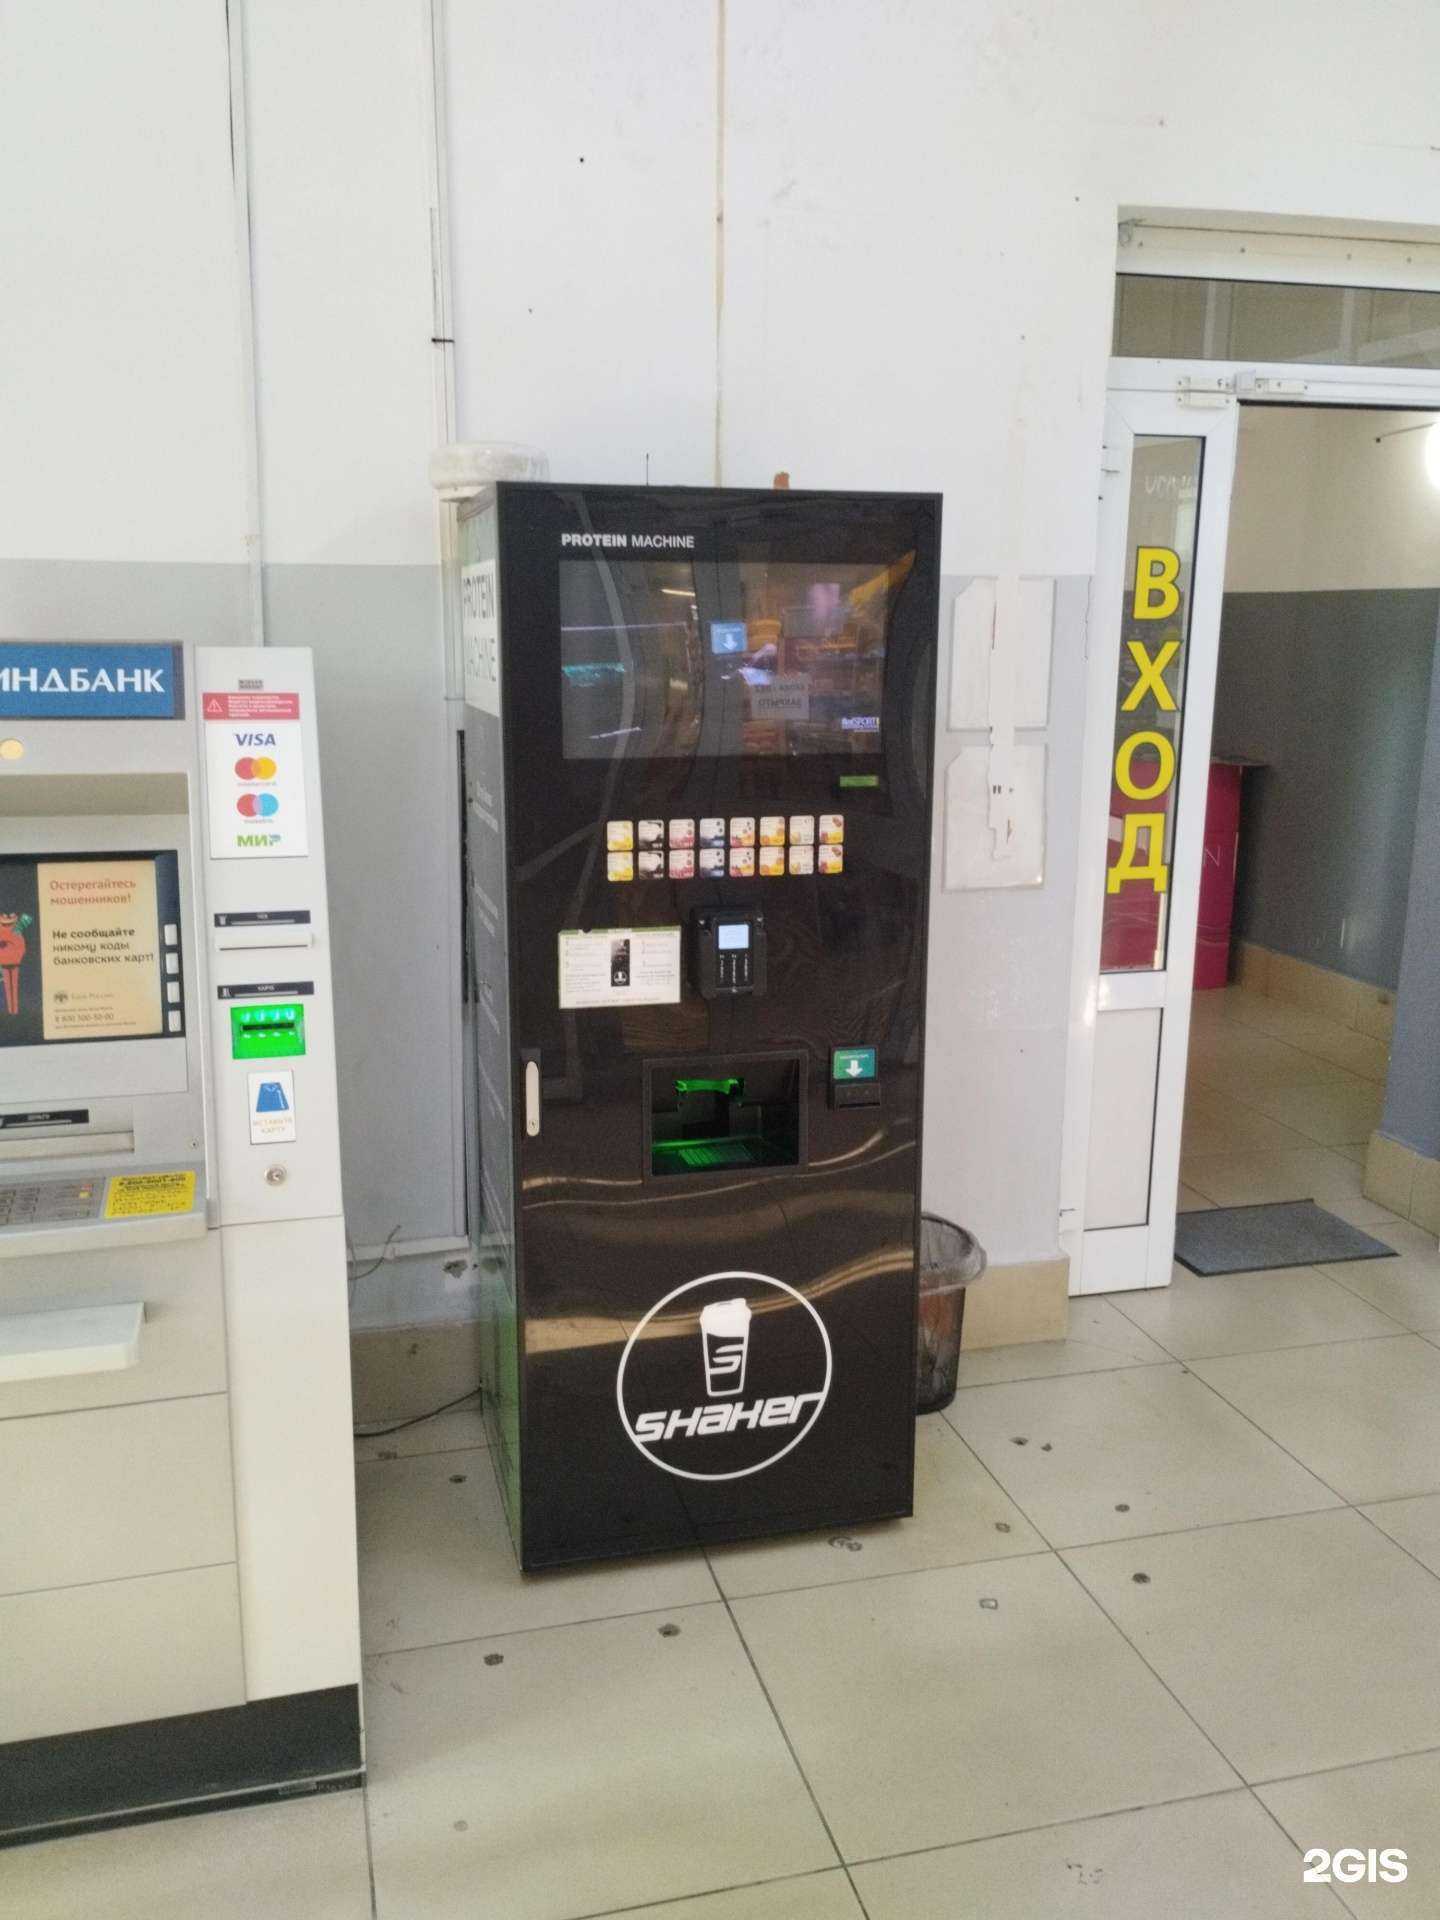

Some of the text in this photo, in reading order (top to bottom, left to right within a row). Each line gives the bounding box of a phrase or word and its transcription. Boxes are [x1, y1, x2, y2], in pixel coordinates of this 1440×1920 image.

[561, 533, 695, 548] PROTEIN MACHINE
[1106, 546, 1182, 894] ВХОД
[235, 733, 276, 746] VISA
[236, 834, 281, 847] МИР
[49, 878, 137, 891] Остерегайтесь
[50, 894, 132, 906] мошенников!
[52, 928, 136, 939] Не сообщайте
[53, 942, 130, 954] никому коды
[53, 956, 121, 966] банковских
